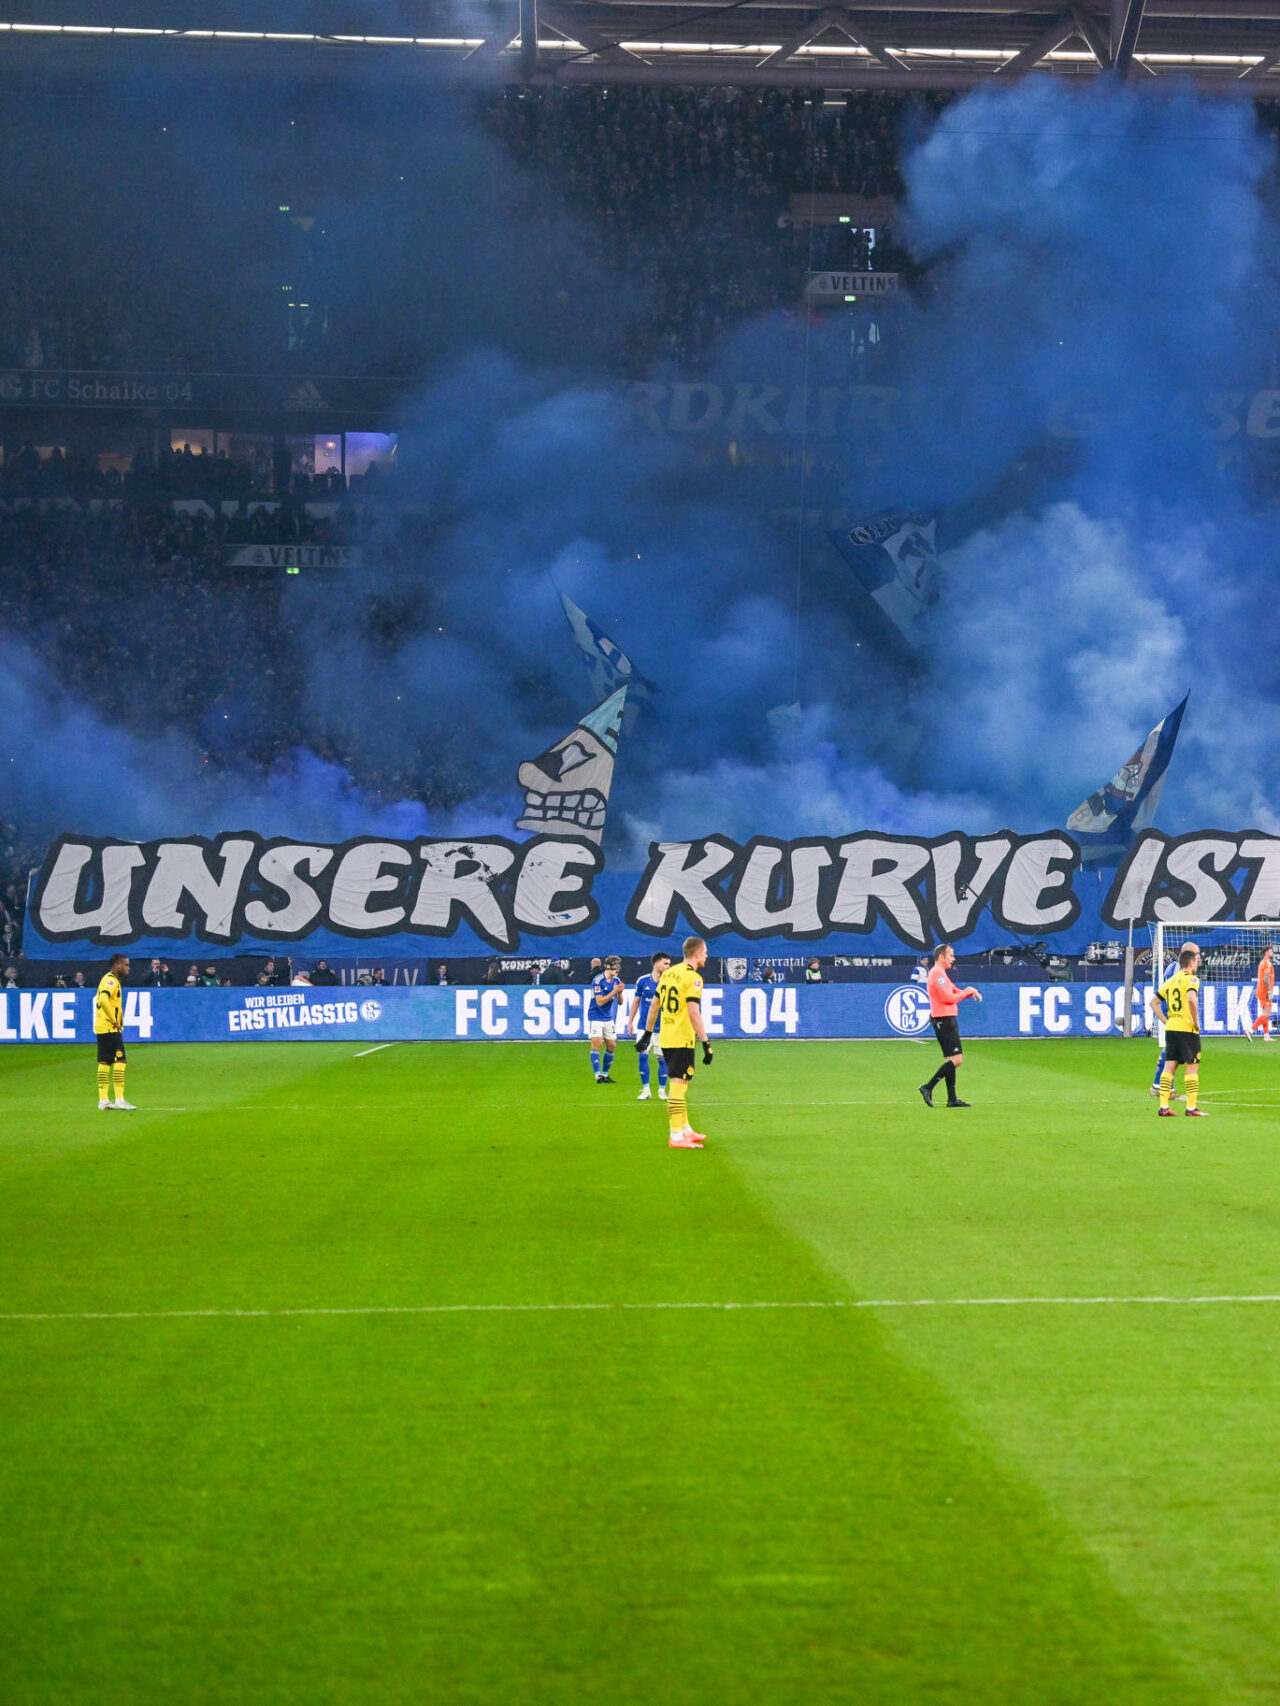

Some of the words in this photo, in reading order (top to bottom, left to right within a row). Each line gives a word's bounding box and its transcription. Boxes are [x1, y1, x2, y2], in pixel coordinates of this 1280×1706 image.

[831, 274, 896, 292] VELTINS
[30, 379, 60, 398] FC
[67, 378, 158, 401] Schalke
[165, 381, 193, 401] 04
[36, 835, 599, 946] UNSERE
[634, 837, 1074, 945] KURVE
[245, 997, 265, 1009] WIR
[266, 993, 306, 1008] BLEIBEN
[455, 989, 509, 1036] FC
[739, 987, 800, 1034] 04
[1018, 985, 1072, 1033] FC
[1166, 987, 1183, 1012] 13
[228, 1001, 358, 1032] ERSTKLASSIG
